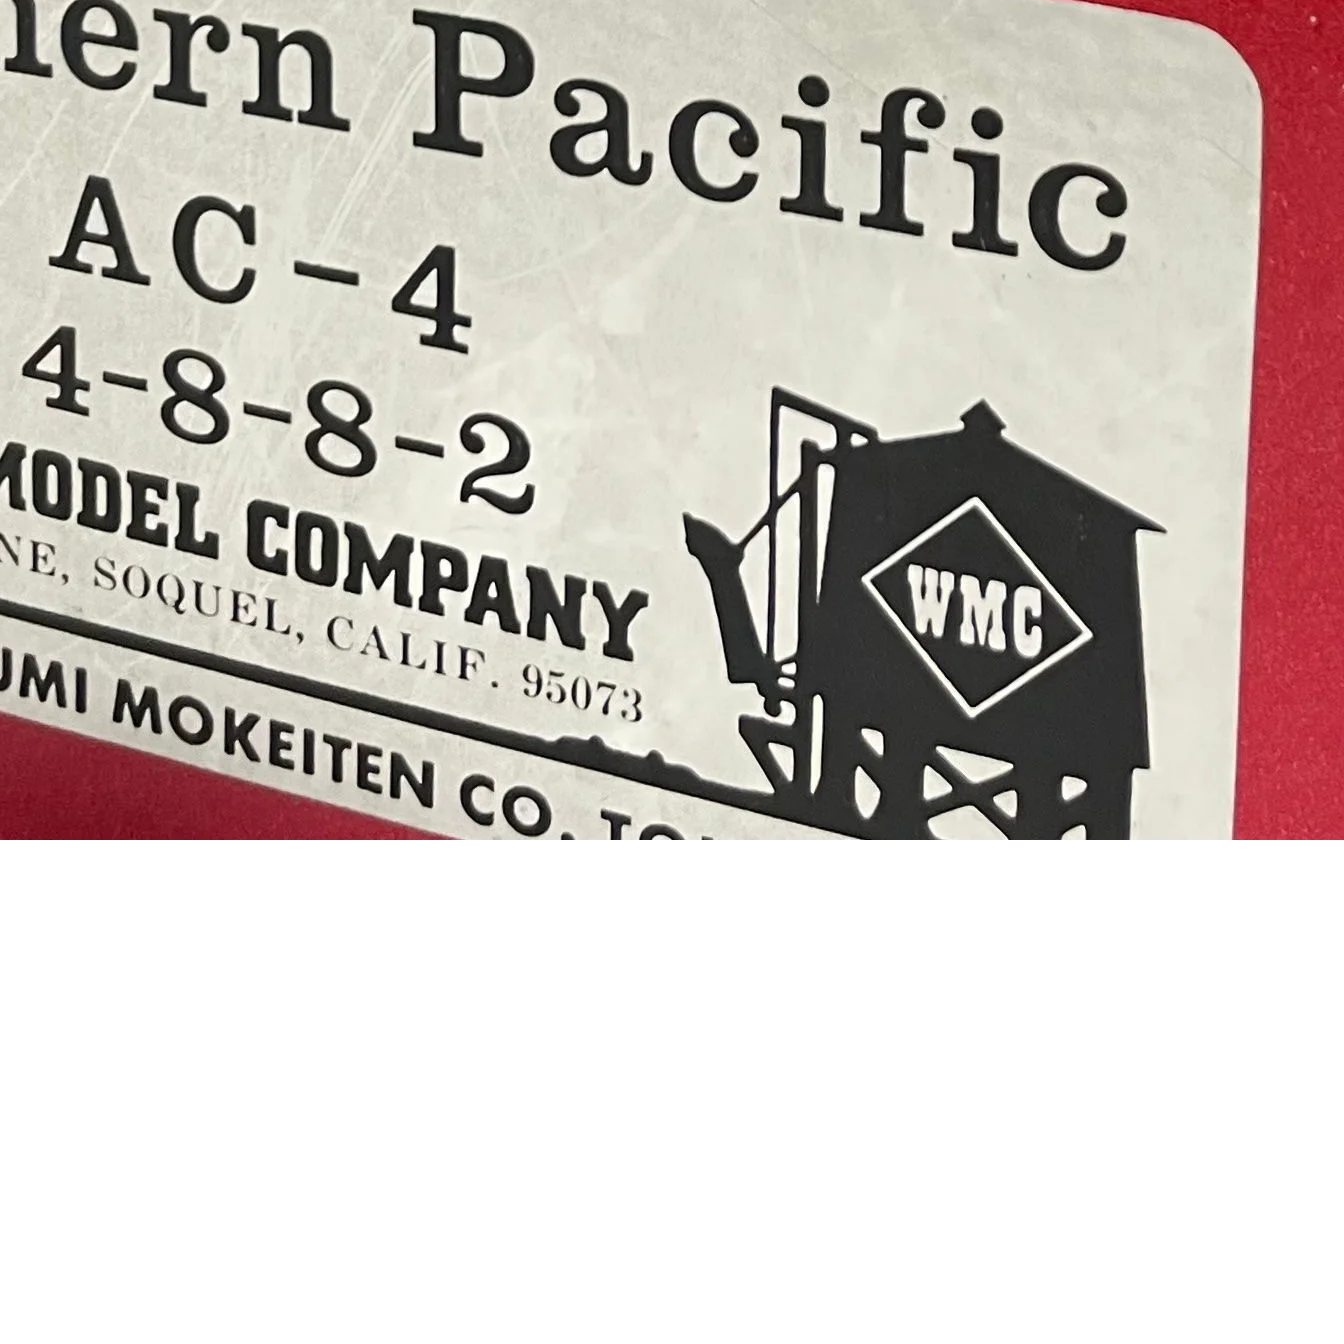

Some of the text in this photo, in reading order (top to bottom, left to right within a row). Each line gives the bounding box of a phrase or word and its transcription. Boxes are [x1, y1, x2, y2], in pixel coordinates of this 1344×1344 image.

[411, 8, 1129, 272] Pacific
[20, 324, 536, 515] 4-8-8-2
[93, 556, 305, 645] SOQUEL,
[326, 615, 500, 689] CALIF.
[522, 663, 644, 724] 95073
[245, 499, 650, 663] COMPANY
[907, 563, 1043, 659] WMC
[113, 678, 435, 810] MOKEITEN
[460, 774, 575, 840] CO.
